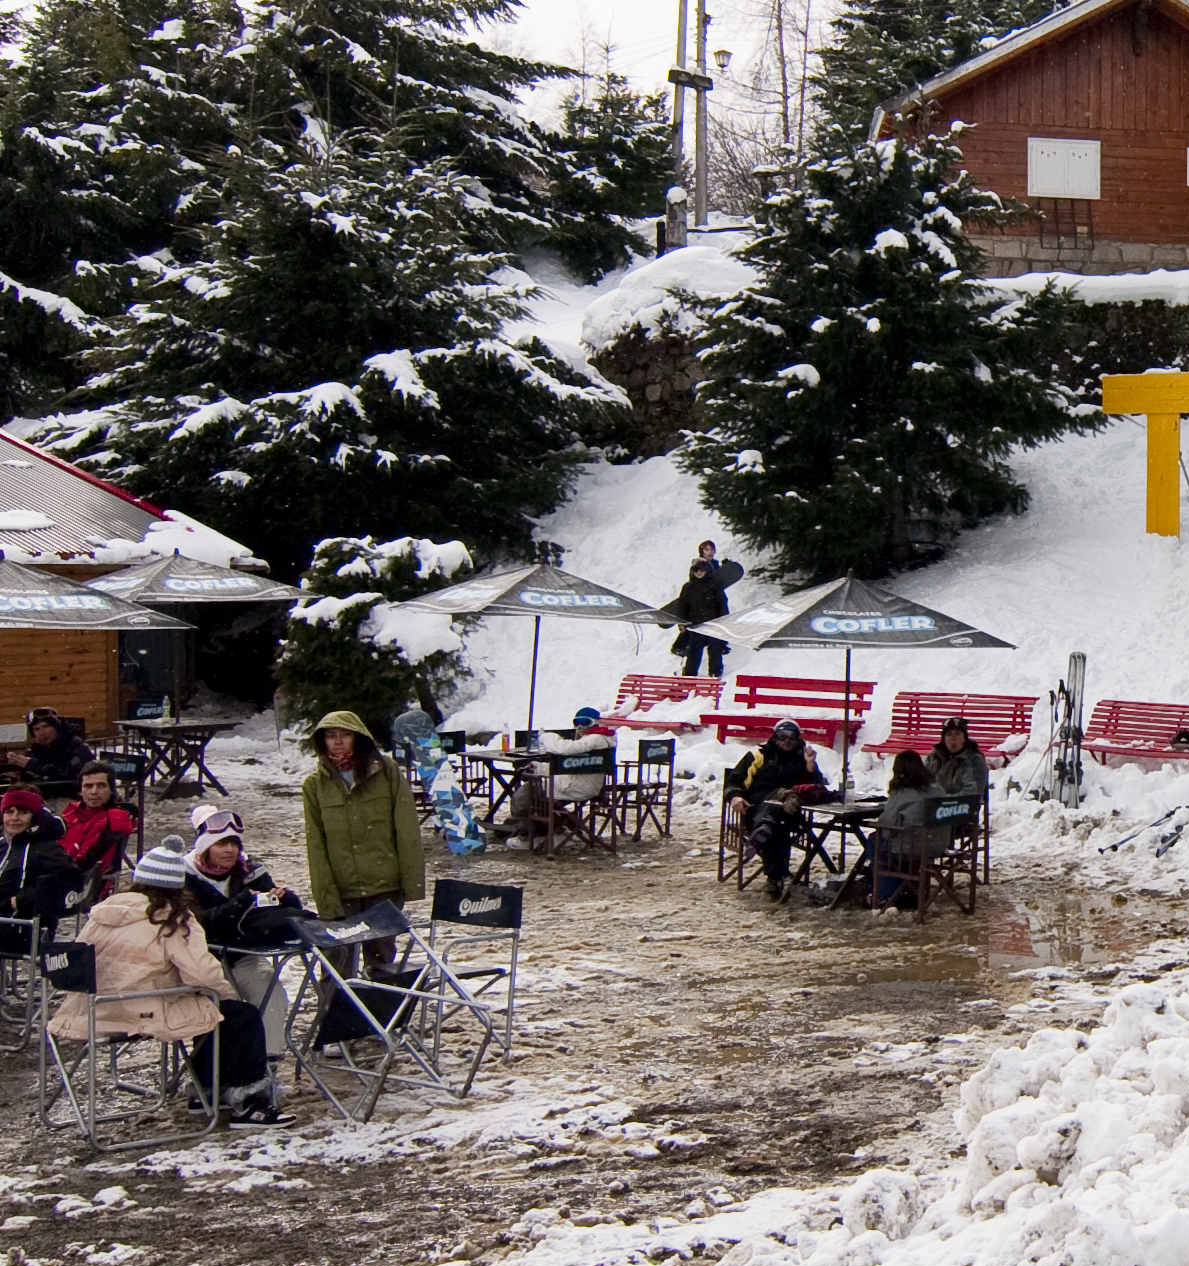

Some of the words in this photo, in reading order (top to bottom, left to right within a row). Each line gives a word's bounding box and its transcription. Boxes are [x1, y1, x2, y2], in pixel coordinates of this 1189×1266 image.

[164, 577, 259, 591] COFLER
[519, 590, 623, 608] COFLER
[812, 615, 938, 635] COFLER
[136, 706, 165, 717] COFLE
[562, 756, 604, 769] COFLER
[936, 803, 970, 819] COFLER
[45, 951, 69, 972] lmes
